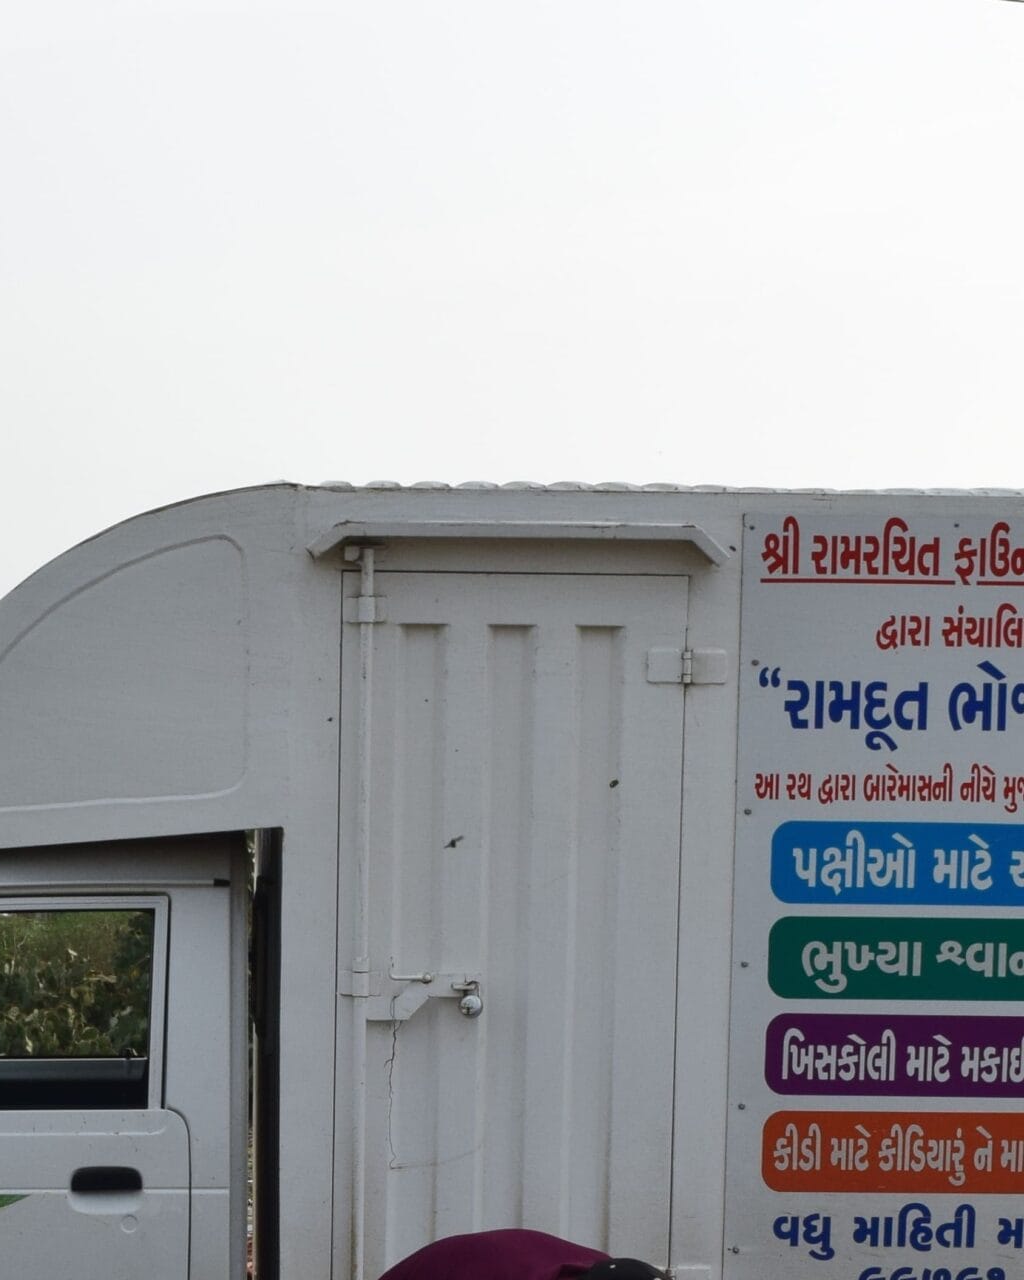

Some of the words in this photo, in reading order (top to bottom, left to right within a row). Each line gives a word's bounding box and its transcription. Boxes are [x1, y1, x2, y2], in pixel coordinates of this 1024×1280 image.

[761, 516, 800, 575] શ્રી
[811, 517, 940, 576] રામરચિત
[876, 615, 930, 650] દ્વારા
[755, 773, 780, 800] આ
[786, 773, 812, 800] રથ
[818, 774, 856, 804] દ્વારા
[863, 763, 953, 802] બારેમાસની
[960, 763, 996, 803] નીચે
[792, 829, 916, 895] પક્ષીઓ
[933, 833, 993, 890] માટે
[802, 940, 922, 993] ભુખ્યા
[782, 1028, 896, 1081] ખિસકોલી
[906, 1034, 952, 1082] માટે
[773, 1123, 821, 1171] કીડી
[831, 1124, 871, 1171] માટે
[974, 1126, 993, 1172] ને
[773, 1213, 835, 1261] વધુ
[853, 1203, 976, 1252] માહિતી
